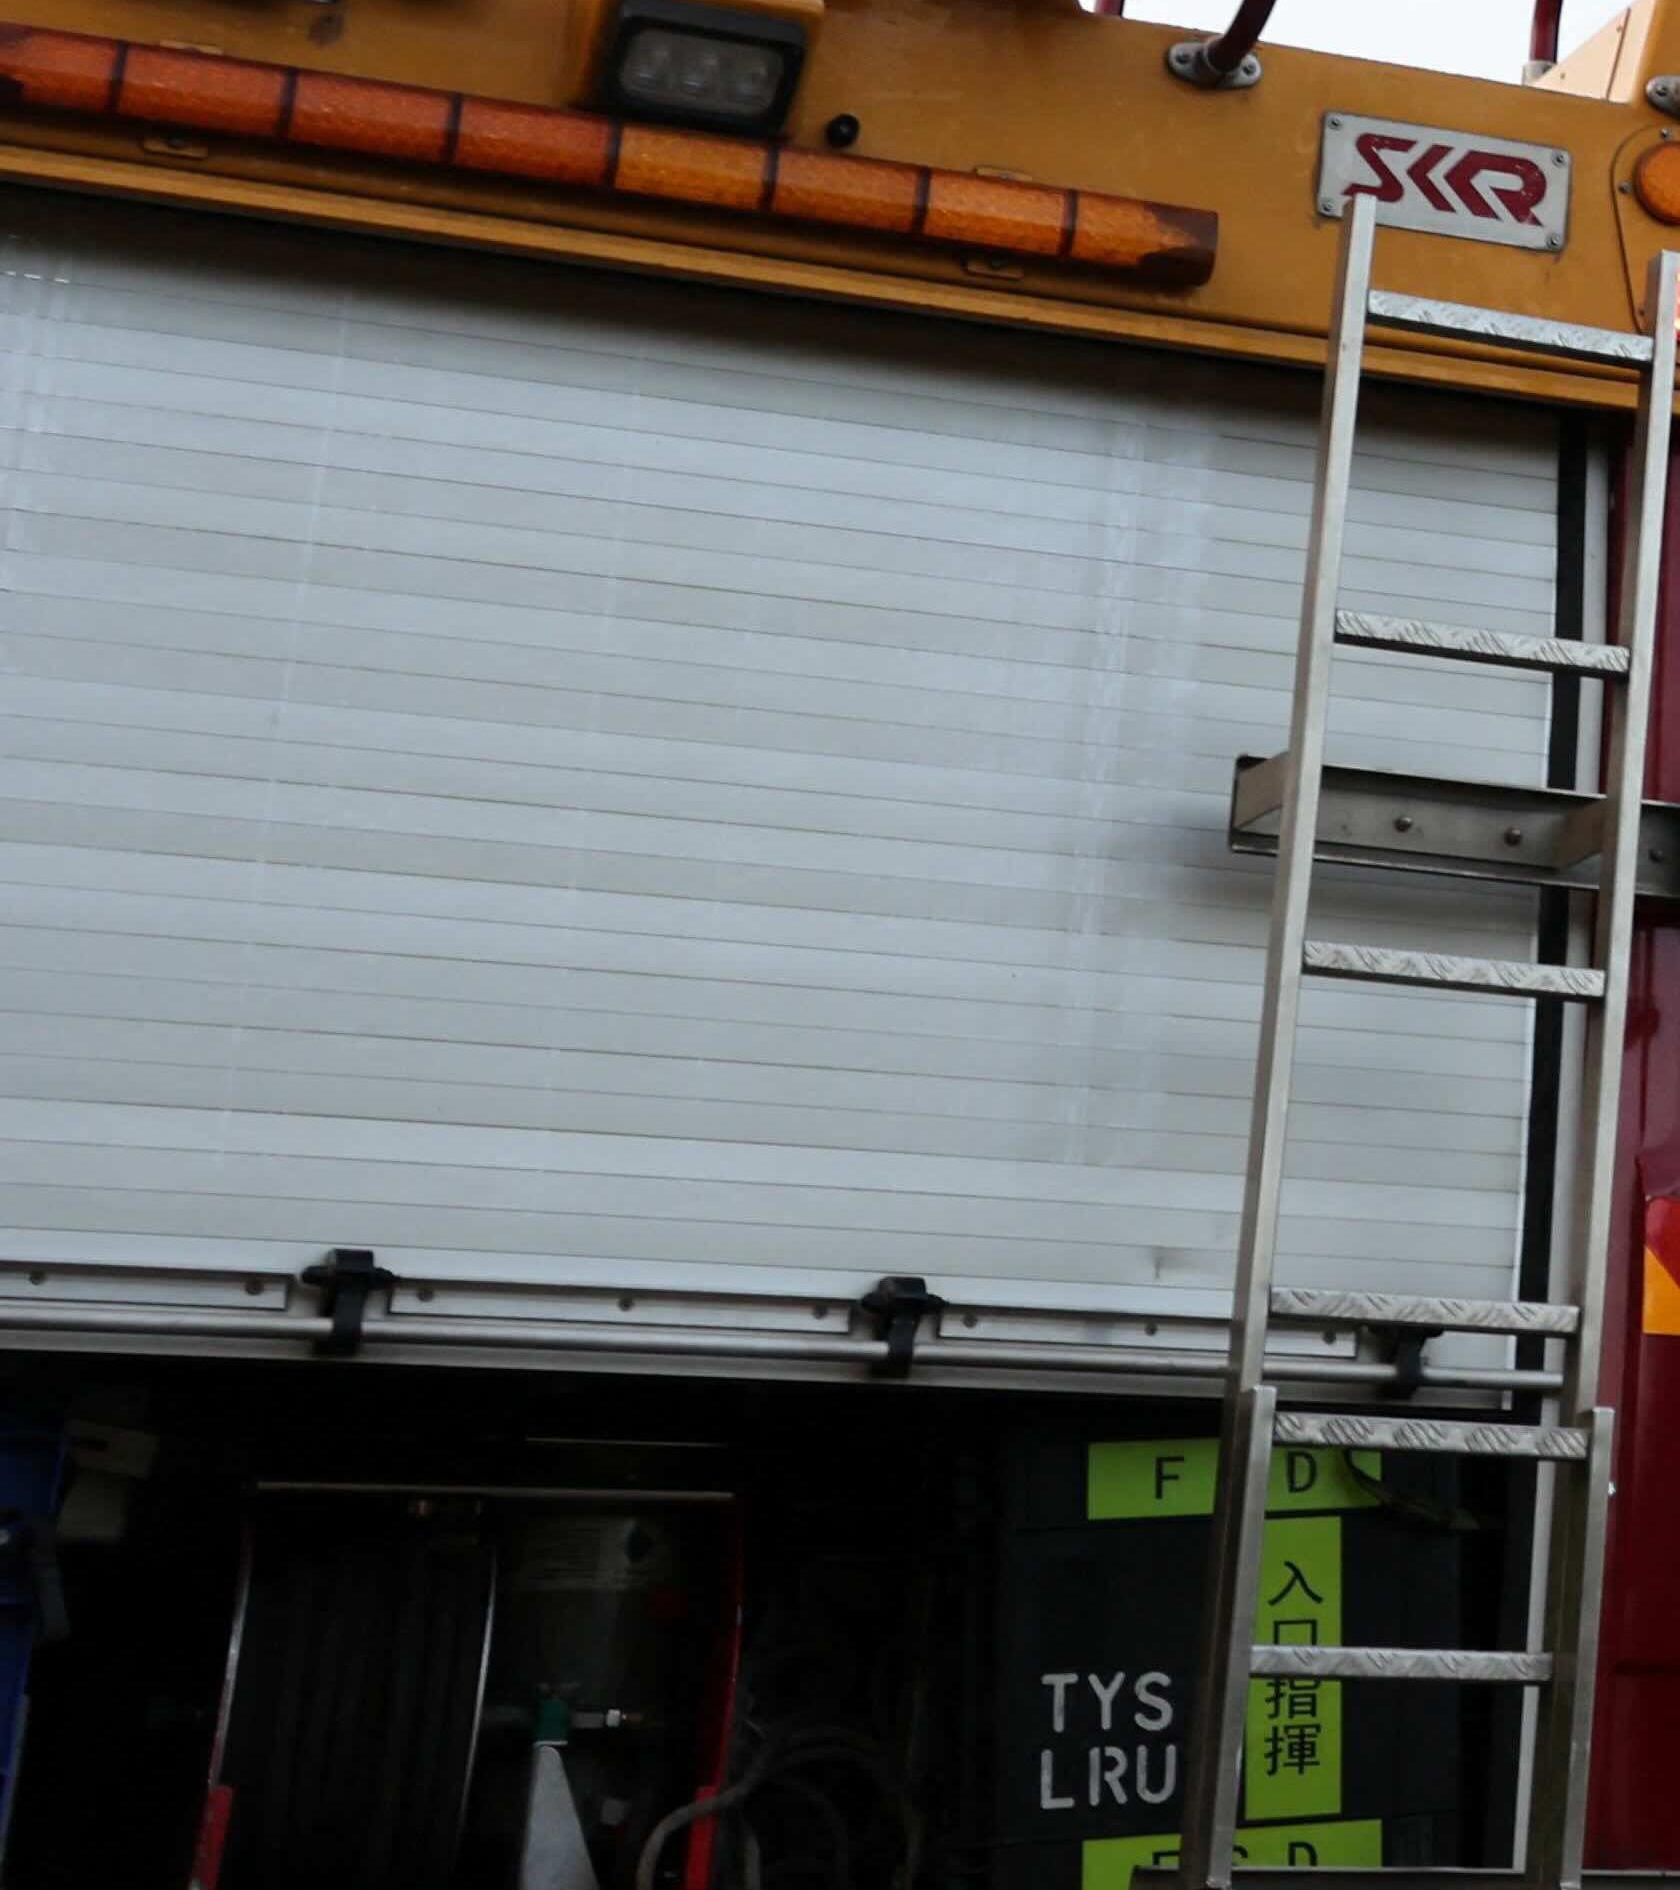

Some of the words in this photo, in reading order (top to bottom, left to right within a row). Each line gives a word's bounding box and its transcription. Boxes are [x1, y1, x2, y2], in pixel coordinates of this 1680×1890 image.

[1341, 132, 1547, 227] SKR
[1041, 1671, 1173, 1732] TYS
[1040, 1744, 1176, 1810] LRU
